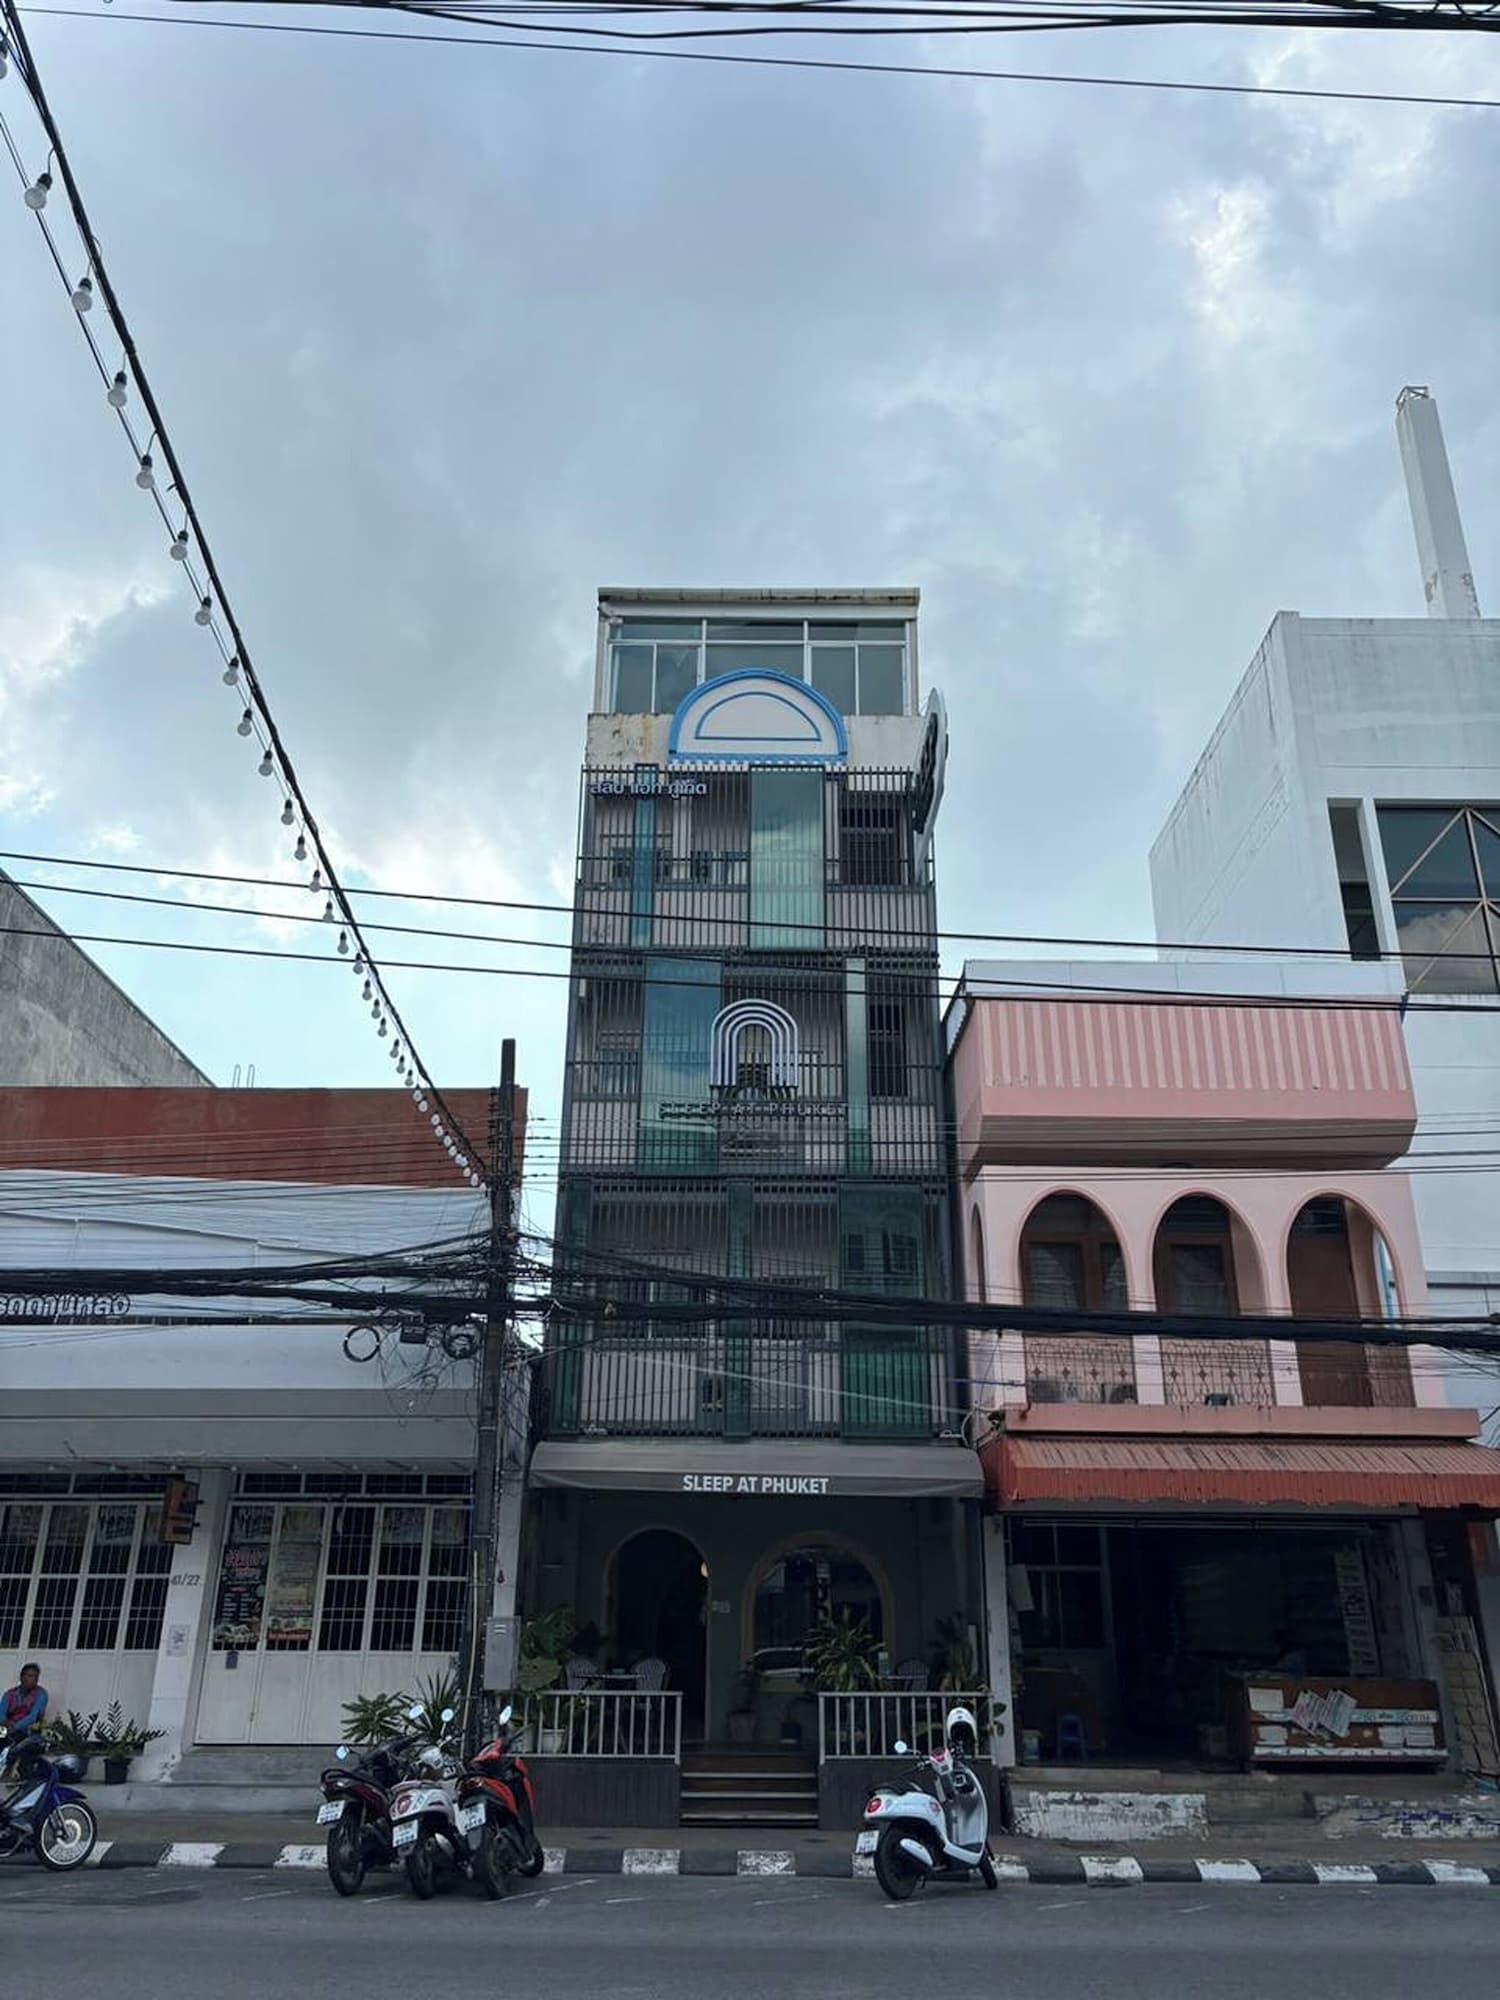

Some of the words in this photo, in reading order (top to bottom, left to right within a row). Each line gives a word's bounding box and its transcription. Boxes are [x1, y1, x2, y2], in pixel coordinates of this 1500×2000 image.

[682, 1474, 734, 1492] SLEEP
[736, 1476, 759, 1493] AT
[761, 1476, 830, 1494] PHUKET
